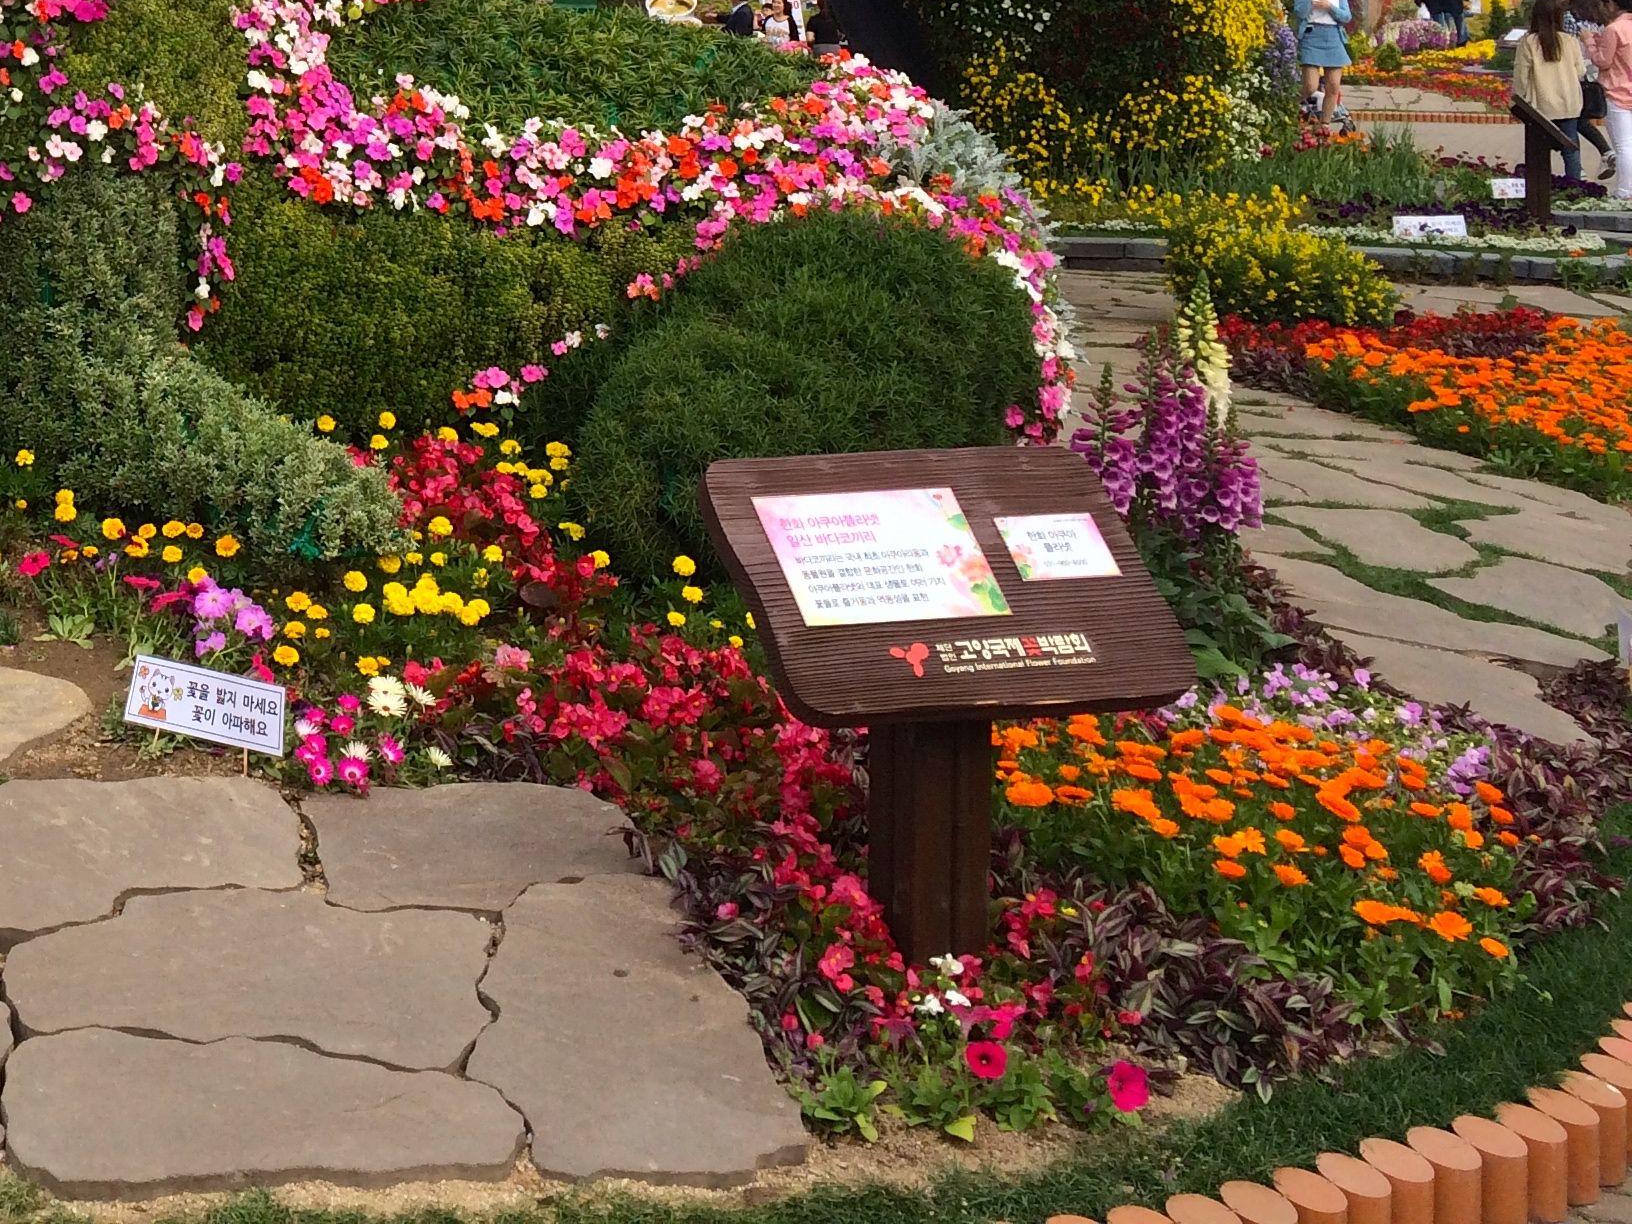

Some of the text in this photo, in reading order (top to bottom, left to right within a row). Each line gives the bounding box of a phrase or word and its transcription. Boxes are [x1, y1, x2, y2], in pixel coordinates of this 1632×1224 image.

[780, 513, 881, 531] 한화 아쿠아플라넷
[787, 530, 877, 548] 일산 바다코끼리
[1026, 529, 1076, 542] 한화 아쿠아
[1043, 541, 1073, 553] 플라넷
[955, 633, 1093, 661] 고양국제꽃박람회
[943, 655, 1097, 675] Goyang International Flower Foundation
[186, 681, 279, 716] 꽃을 밟지 마세요
[191, 704, 269, 737] 꽃이 아파해요
